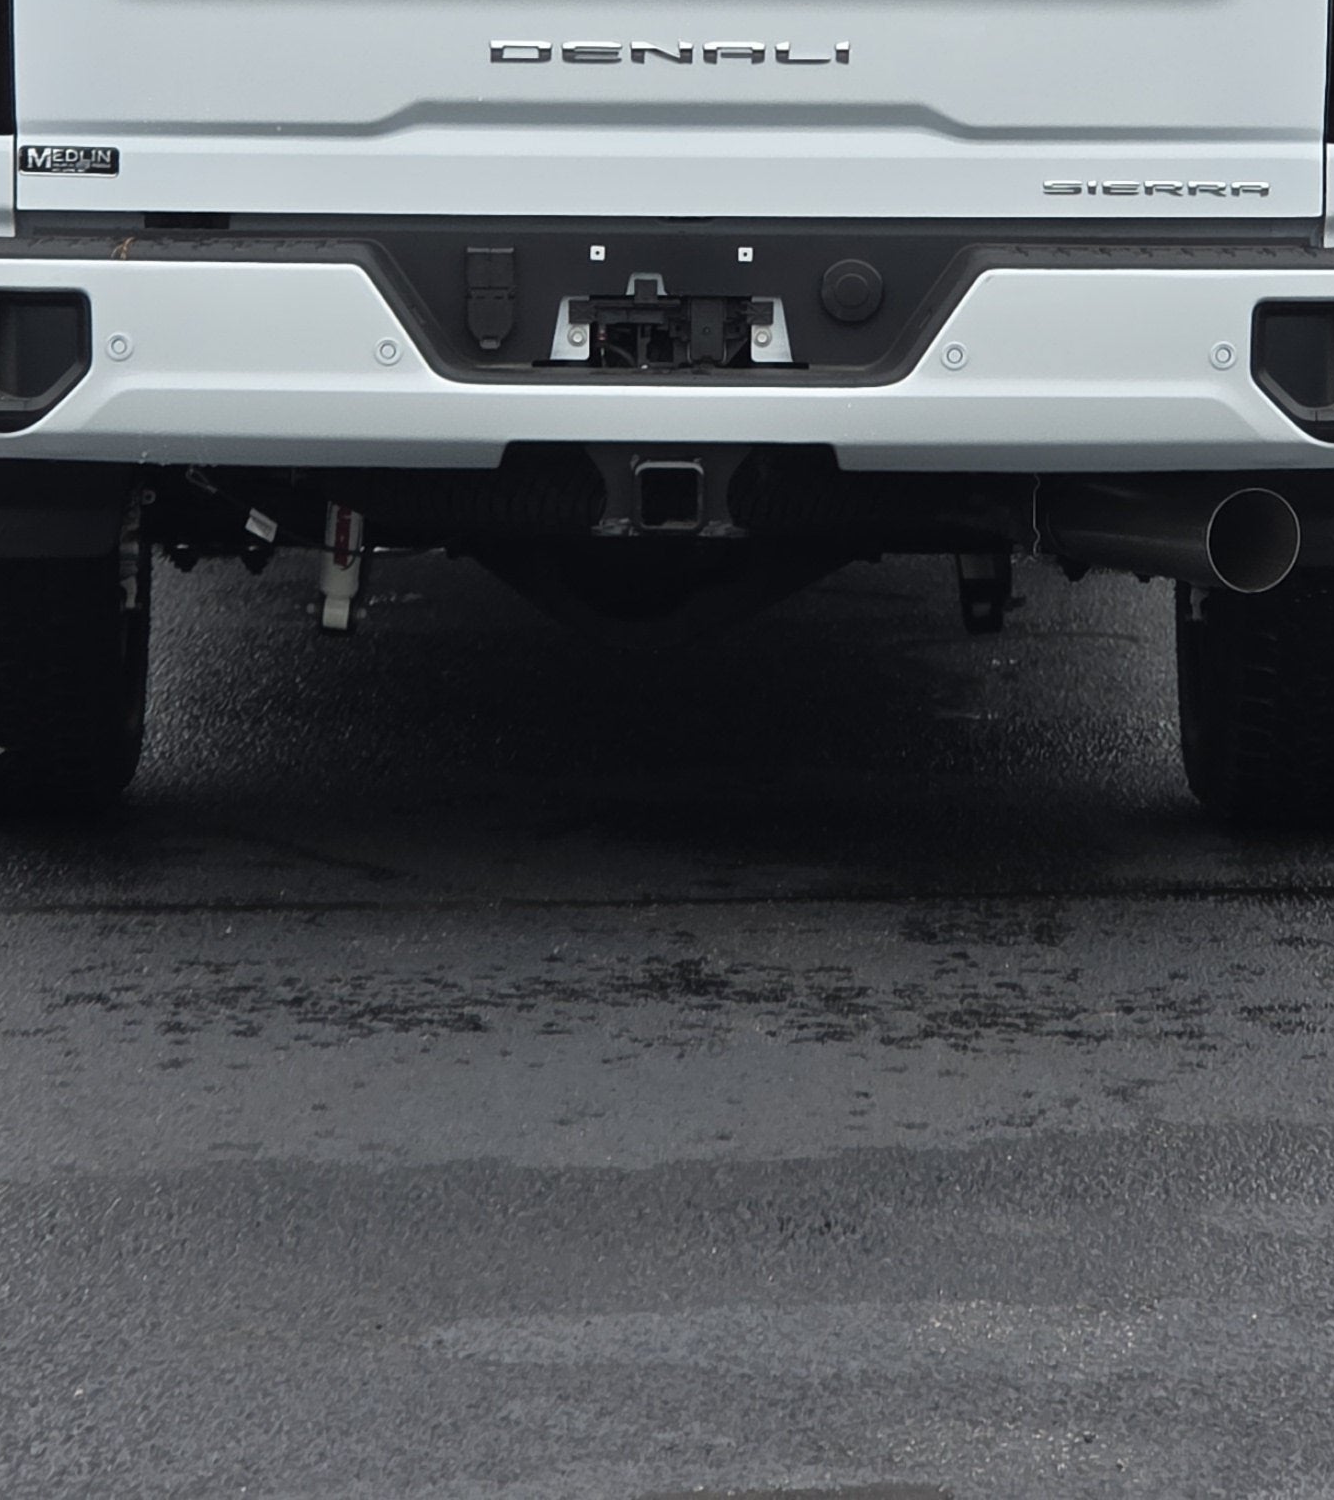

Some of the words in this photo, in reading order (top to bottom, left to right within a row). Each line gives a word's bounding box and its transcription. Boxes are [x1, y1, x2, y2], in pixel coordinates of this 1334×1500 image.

[490, 40, 851, 65] DENALI
[27, 148, 111, 168] MEDLIN
[1042, 180, 1270, 197] SIERRA
